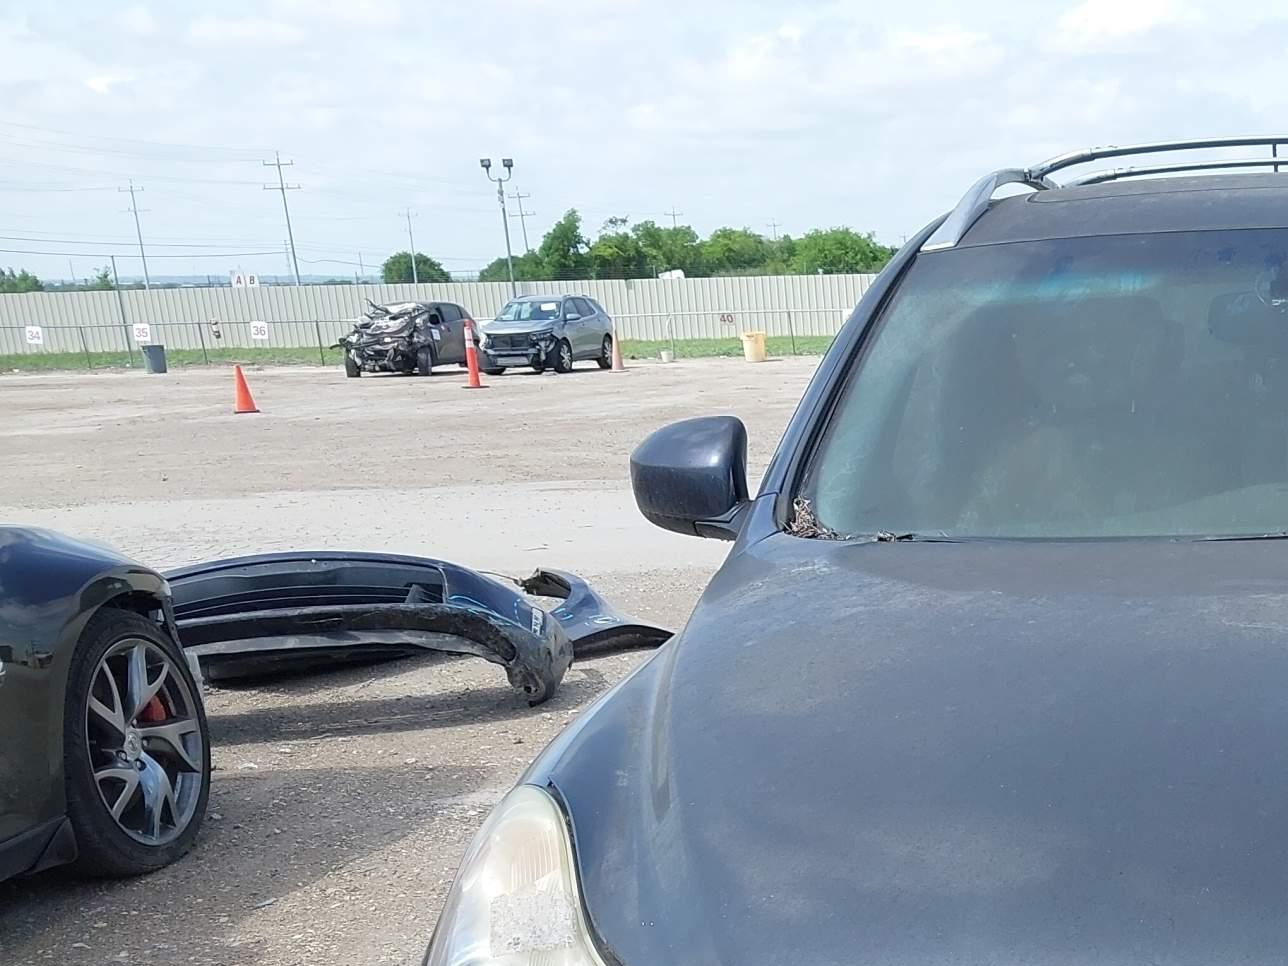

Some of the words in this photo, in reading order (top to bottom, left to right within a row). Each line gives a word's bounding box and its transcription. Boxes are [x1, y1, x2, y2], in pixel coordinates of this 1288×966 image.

[249, 275, 255, 285] B
[27, 330, 40, 341] 34
[135, 327, 148, 338] 35
[252, 325, 266, 336] 36
